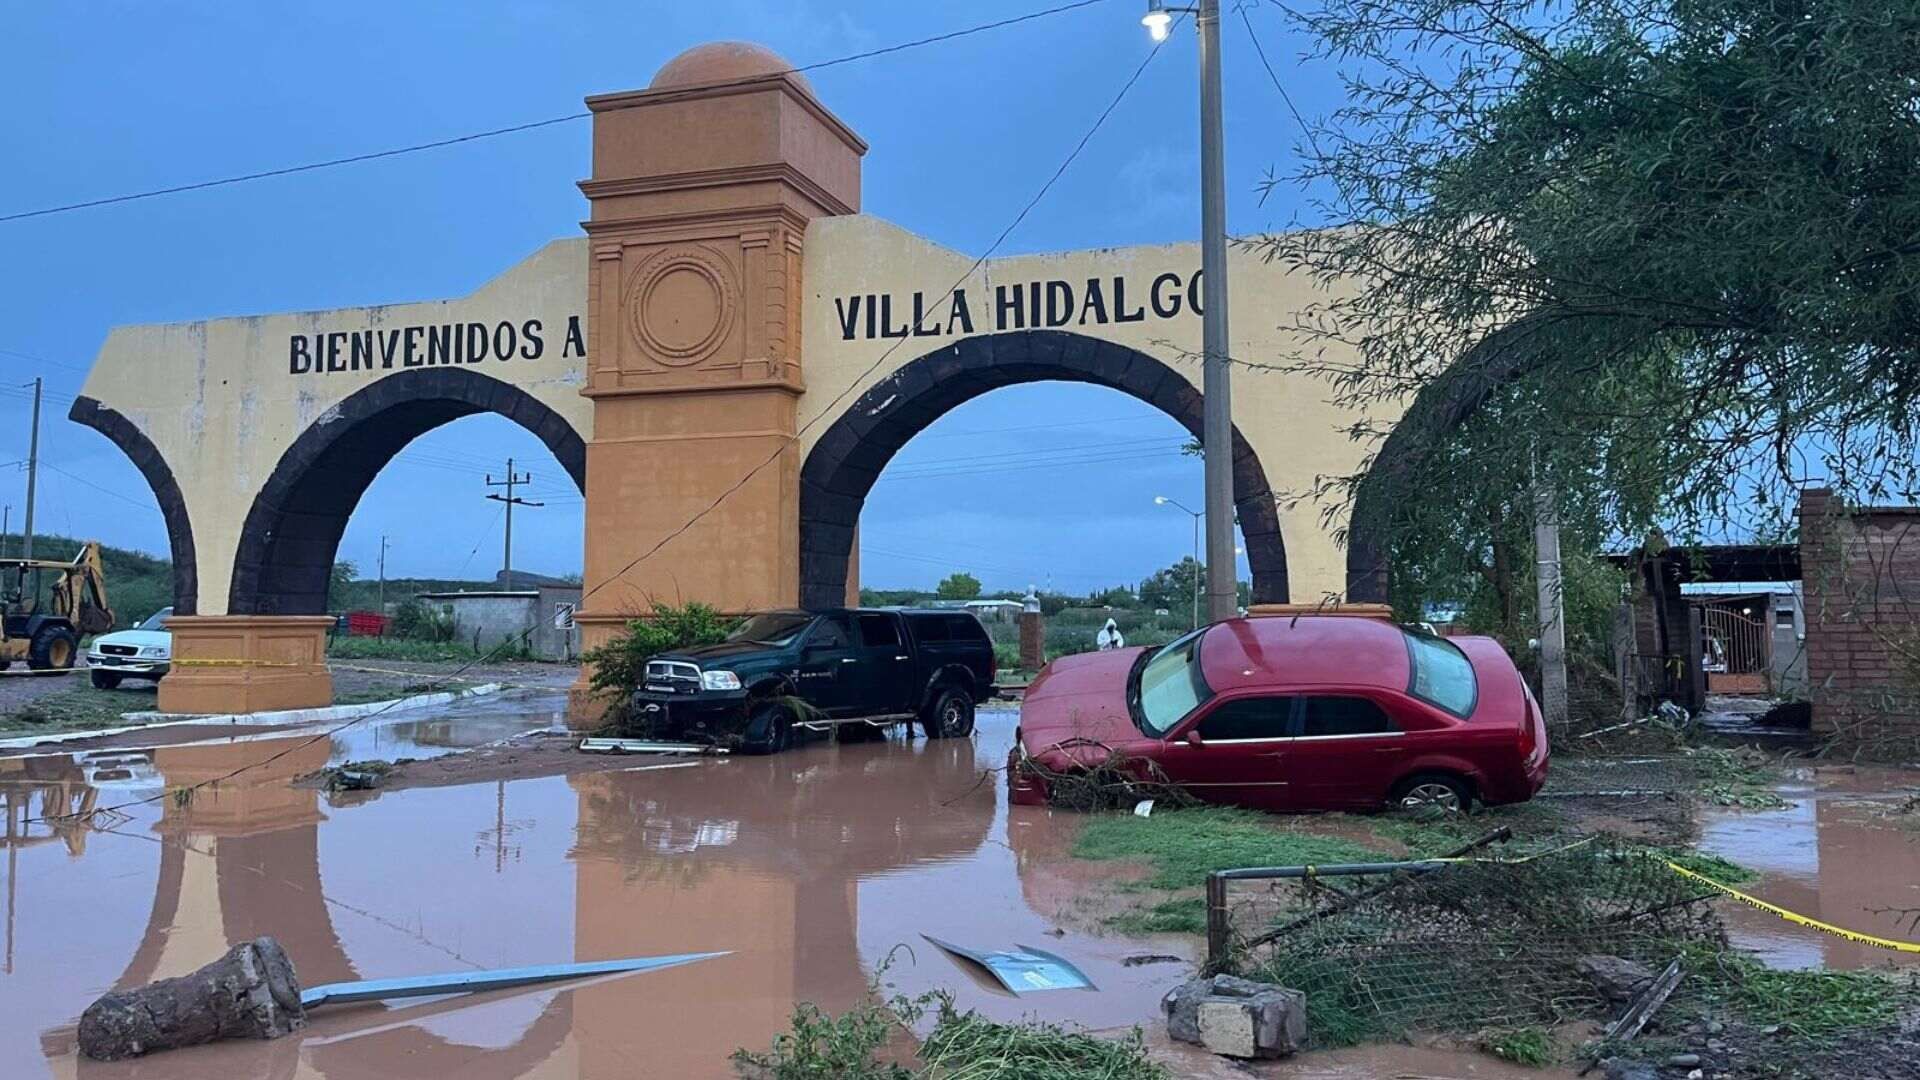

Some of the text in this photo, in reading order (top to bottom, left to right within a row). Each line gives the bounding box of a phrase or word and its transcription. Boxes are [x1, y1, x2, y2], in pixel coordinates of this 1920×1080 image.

[835, 289, 974, 340] VILLA
[289, 316, 586, 374] BIENVENIDOS A
